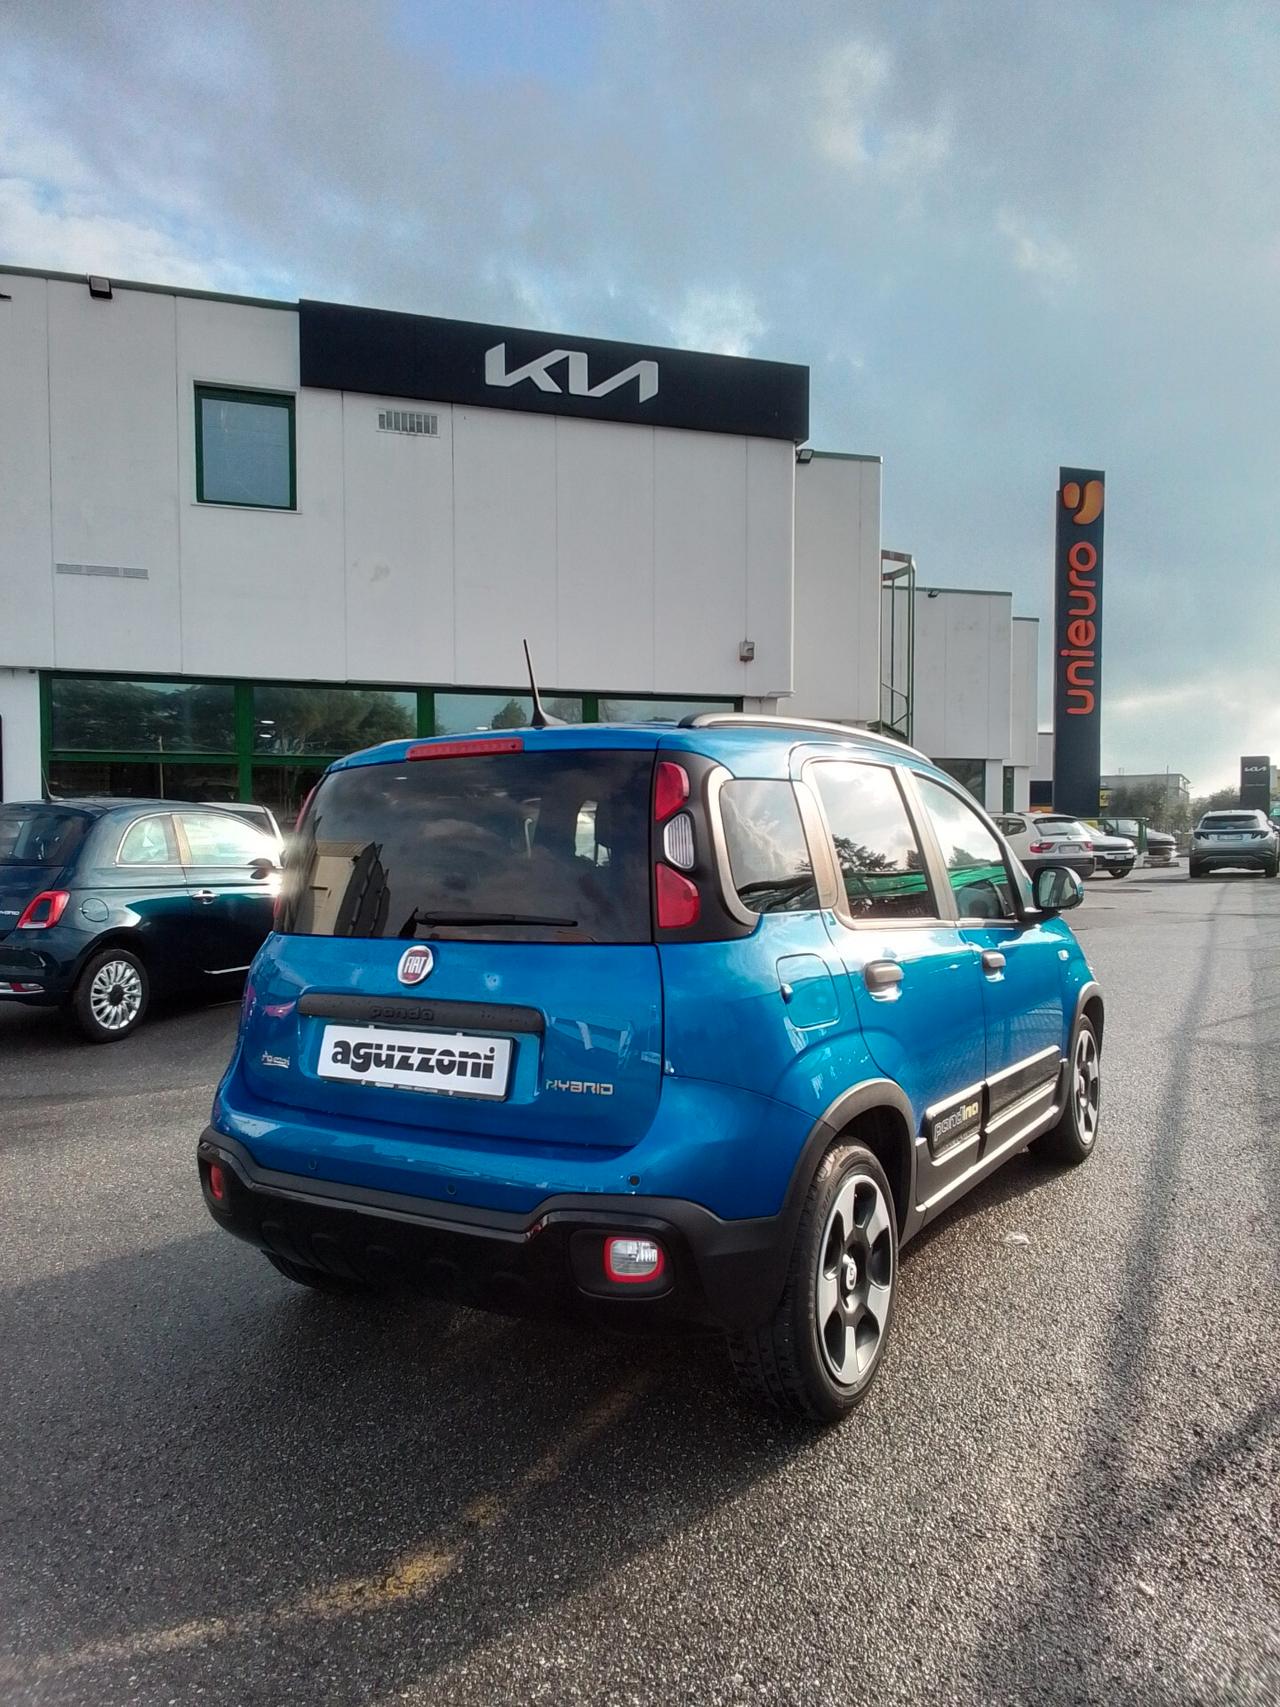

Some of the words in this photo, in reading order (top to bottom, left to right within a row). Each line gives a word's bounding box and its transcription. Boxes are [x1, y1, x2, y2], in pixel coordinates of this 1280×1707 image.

[1061, 541, 1098, 715] unieuro
[403, 956, 427, 974] FIAT
[368, 1005, 434, 1021] panda
[331, 1040, 496, 1080] aguzzoni
[545, 1079, 614, 1096] HYBRID
